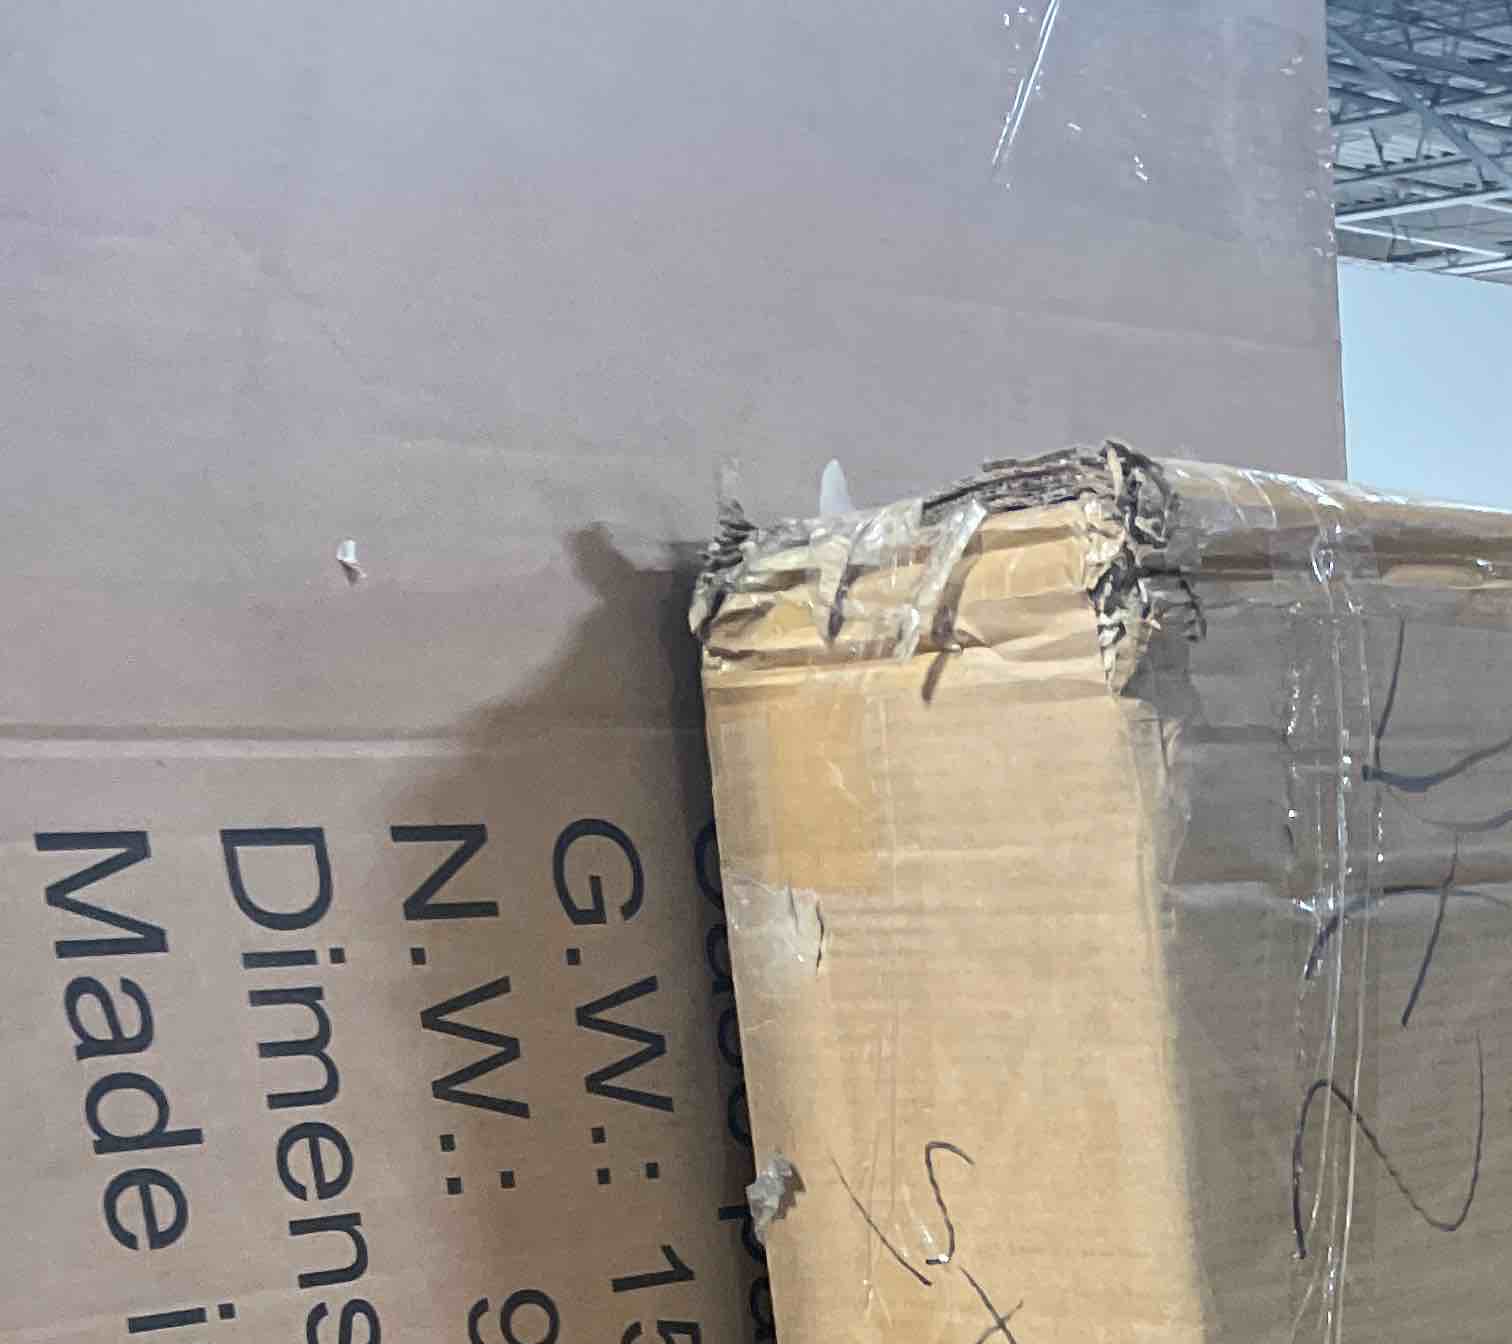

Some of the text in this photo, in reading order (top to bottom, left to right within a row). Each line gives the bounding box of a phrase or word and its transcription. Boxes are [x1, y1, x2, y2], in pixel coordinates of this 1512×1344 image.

[34, 828, 204, 1252] Made
[390, 822, 530, 1195] N.W.:
[553, 817, 675, 1188] G.W.:
